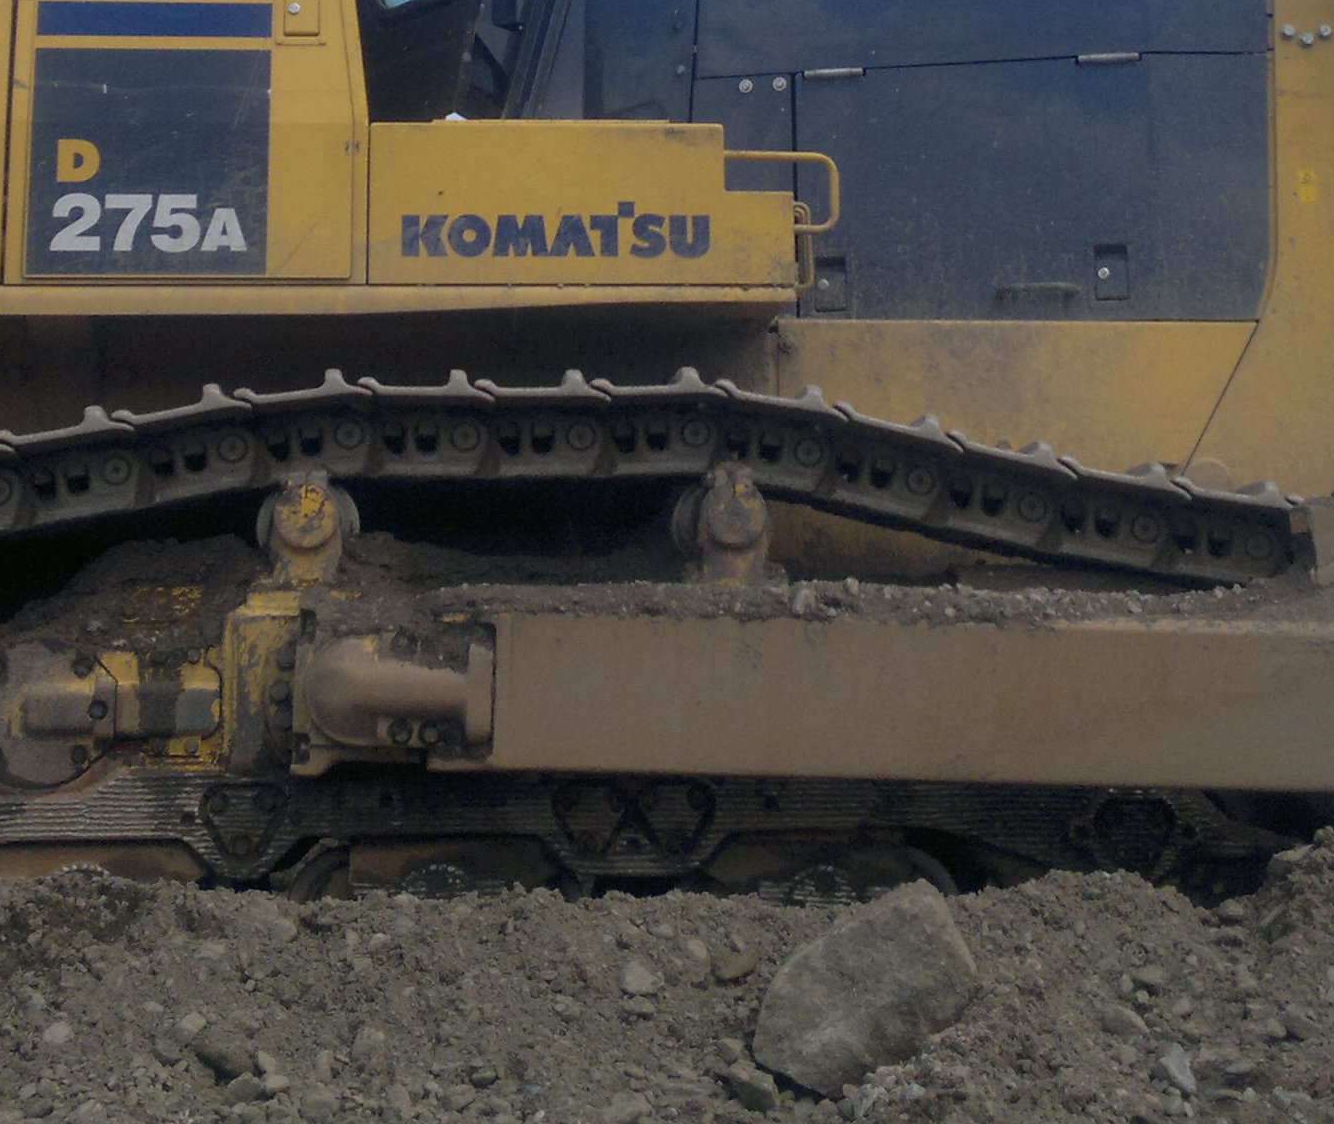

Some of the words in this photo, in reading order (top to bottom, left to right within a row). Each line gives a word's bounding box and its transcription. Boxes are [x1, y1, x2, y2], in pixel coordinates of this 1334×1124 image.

[57, 138, 101, 183] D
[49, 192, 248, 254] 275A
[401, 201, 711, 259] KOMATSU
